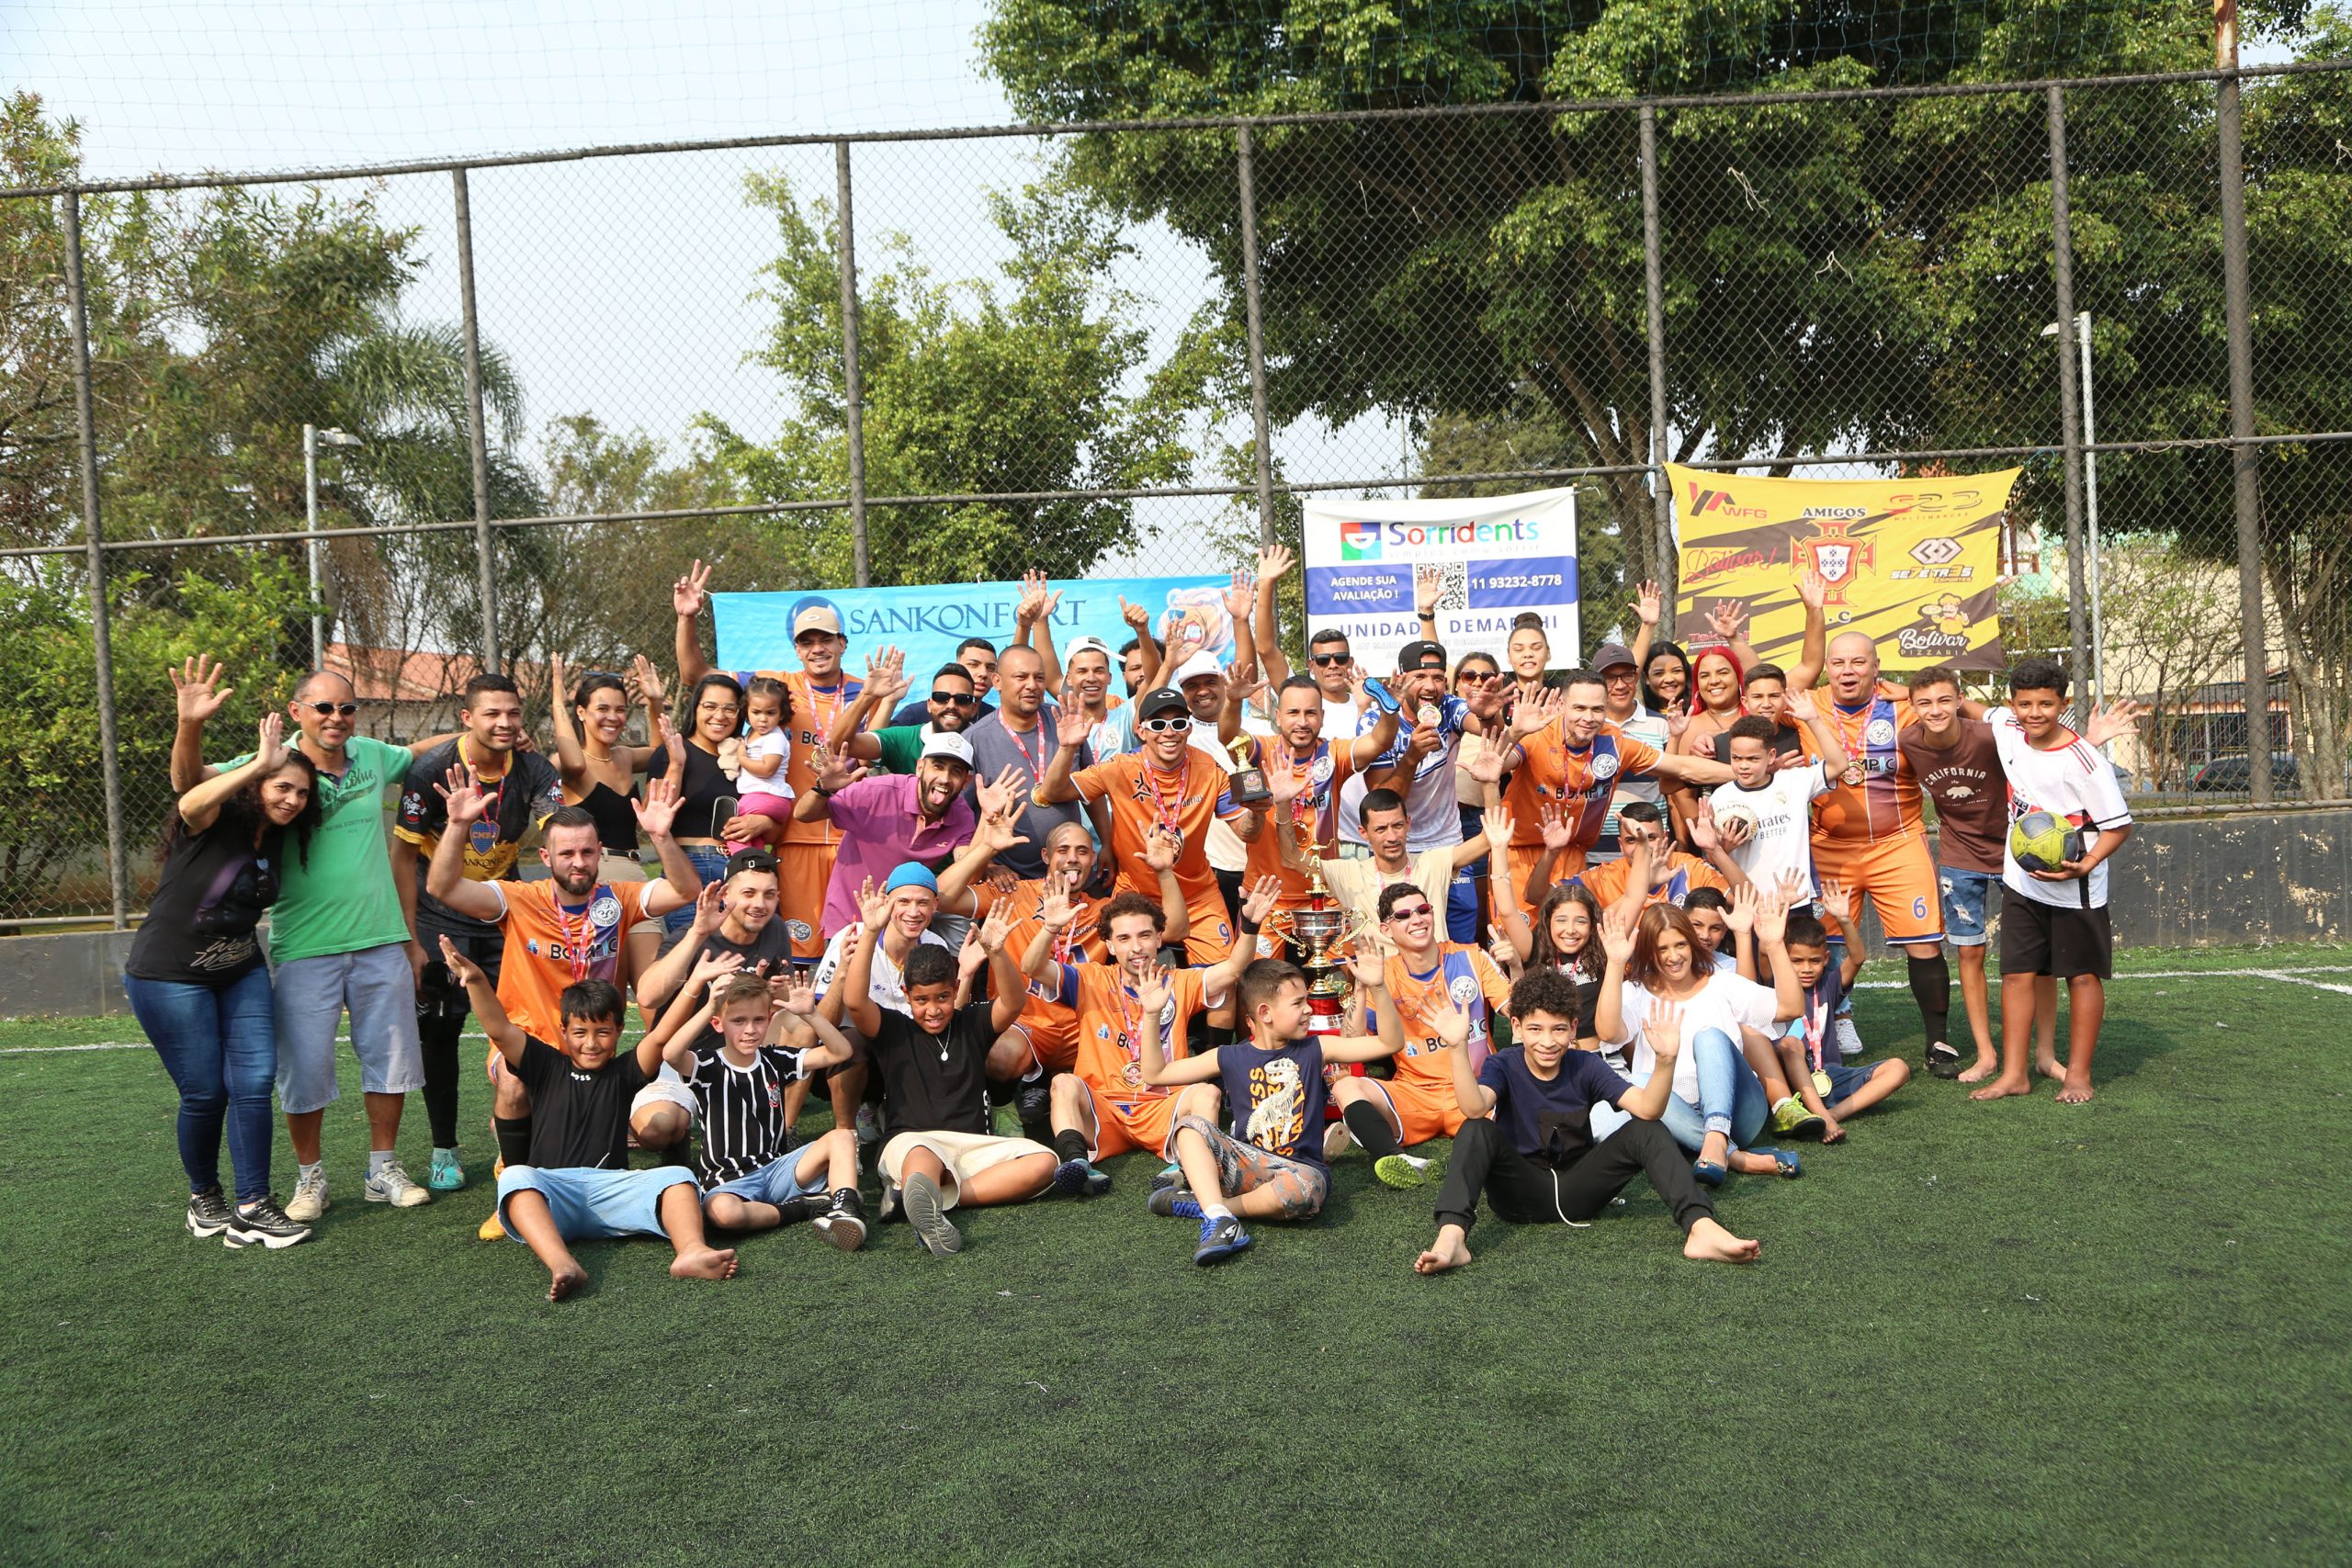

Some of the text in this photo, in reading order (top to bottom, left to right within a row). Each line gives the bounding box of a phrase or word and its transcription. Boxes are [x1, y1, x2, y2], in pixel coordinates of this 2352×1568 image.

[1723, 505, 1768, 518] WFG
[1802, 506, 1867, 518] AMIGOS
[1388, 518, 1539, 547] Sorridents
[1498, 544, 1541, 553] sorrir
[1330, 575, 1396, 587] AGENDE SUA
[1471, 574, 1562, 590] 11 93232-8778
[1332, 588, 1392, 602] AVALIAÇÃO
[850, 600, 1087, 638] SANKONFRT
[1340, 622, 1421, 637] UNIDAD
[1898, 628, 1967, 650] Bolivar
[1900, 649, 1968, 657] PIZZARIA
[1924, 767, 1986, 785] CALIFORNIA
[1757, 813, 1791, 829] irates
[1759, 827, 1787, 840] BETTER
[1912, 895, 1928, 919] 6
[1217, 921, 1231, 945] 9
